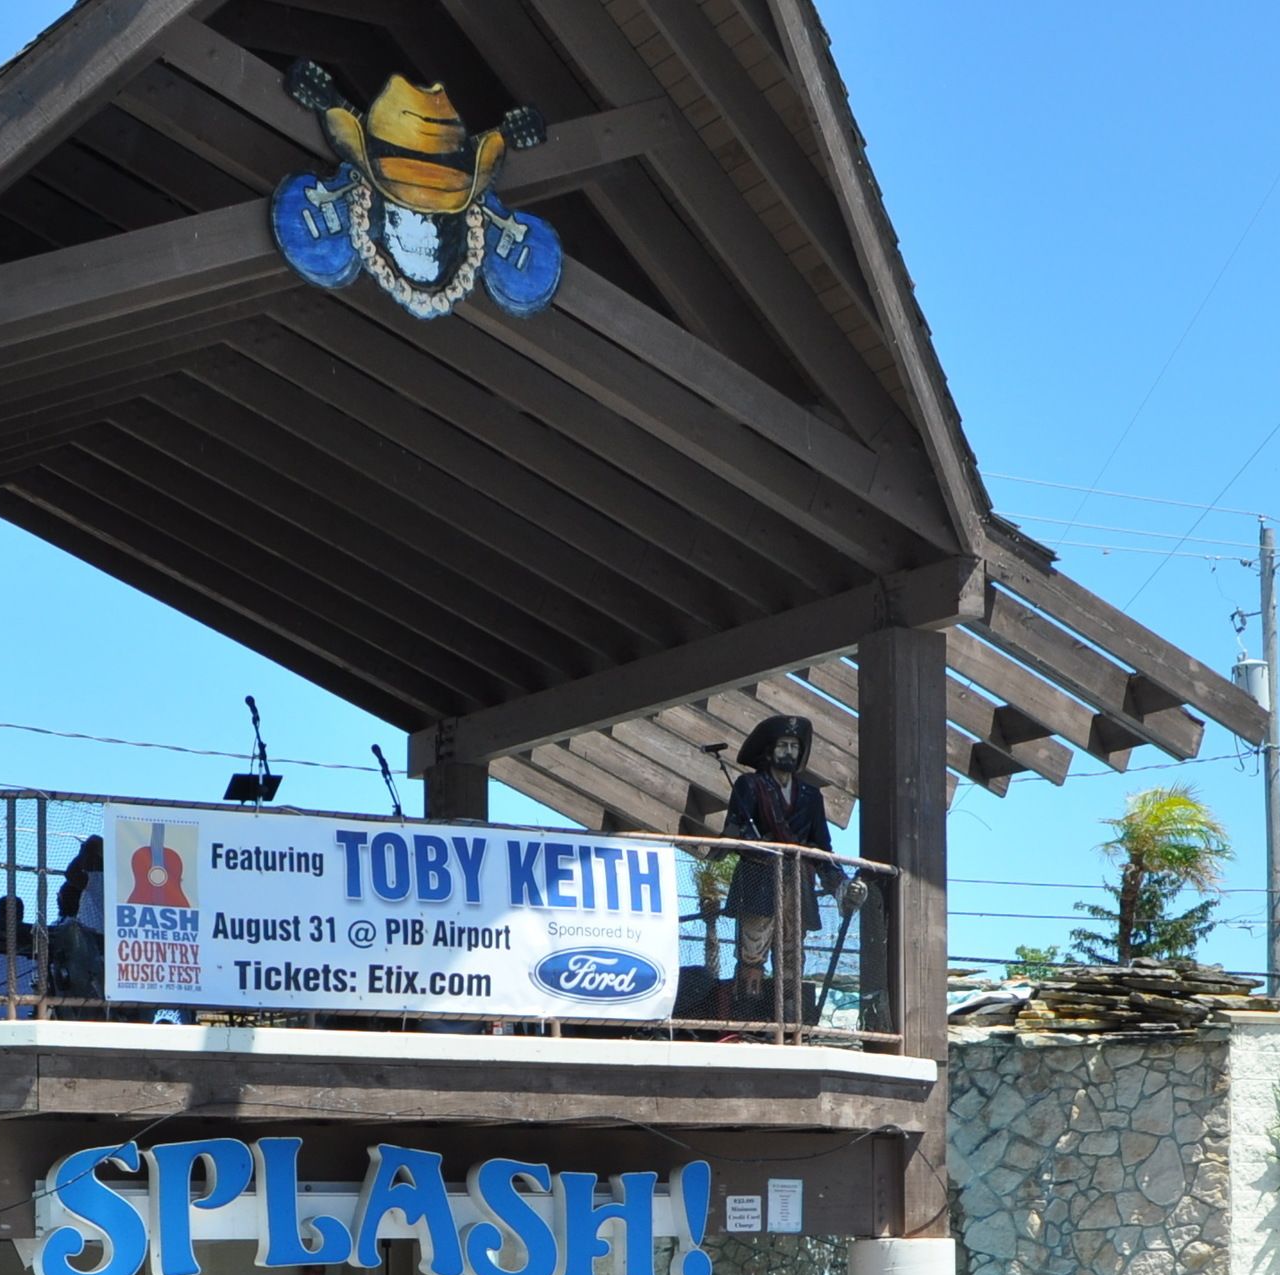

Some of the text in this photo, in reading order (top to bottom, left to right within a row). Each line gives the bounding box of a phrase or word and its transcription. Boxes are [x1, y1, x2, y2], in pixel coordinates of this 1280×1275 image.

[211, 829, 663, 915] Featuring TOBY KEITH
[117, 905, 199, 932] BASH
[212, 912, 511, 951] August 31 @ PIB Airport
[548, 921, 642, 943] Sponsored by
[117, 928, 198, 943] ON THE BAY
[118, 940, 200, 965] COUNTRY
[118, 963, 201, 984] MUSIC FEST
[234, 960, 492, 997] Tickets: Etix.com
[559, 954, 638, 993] Ford
